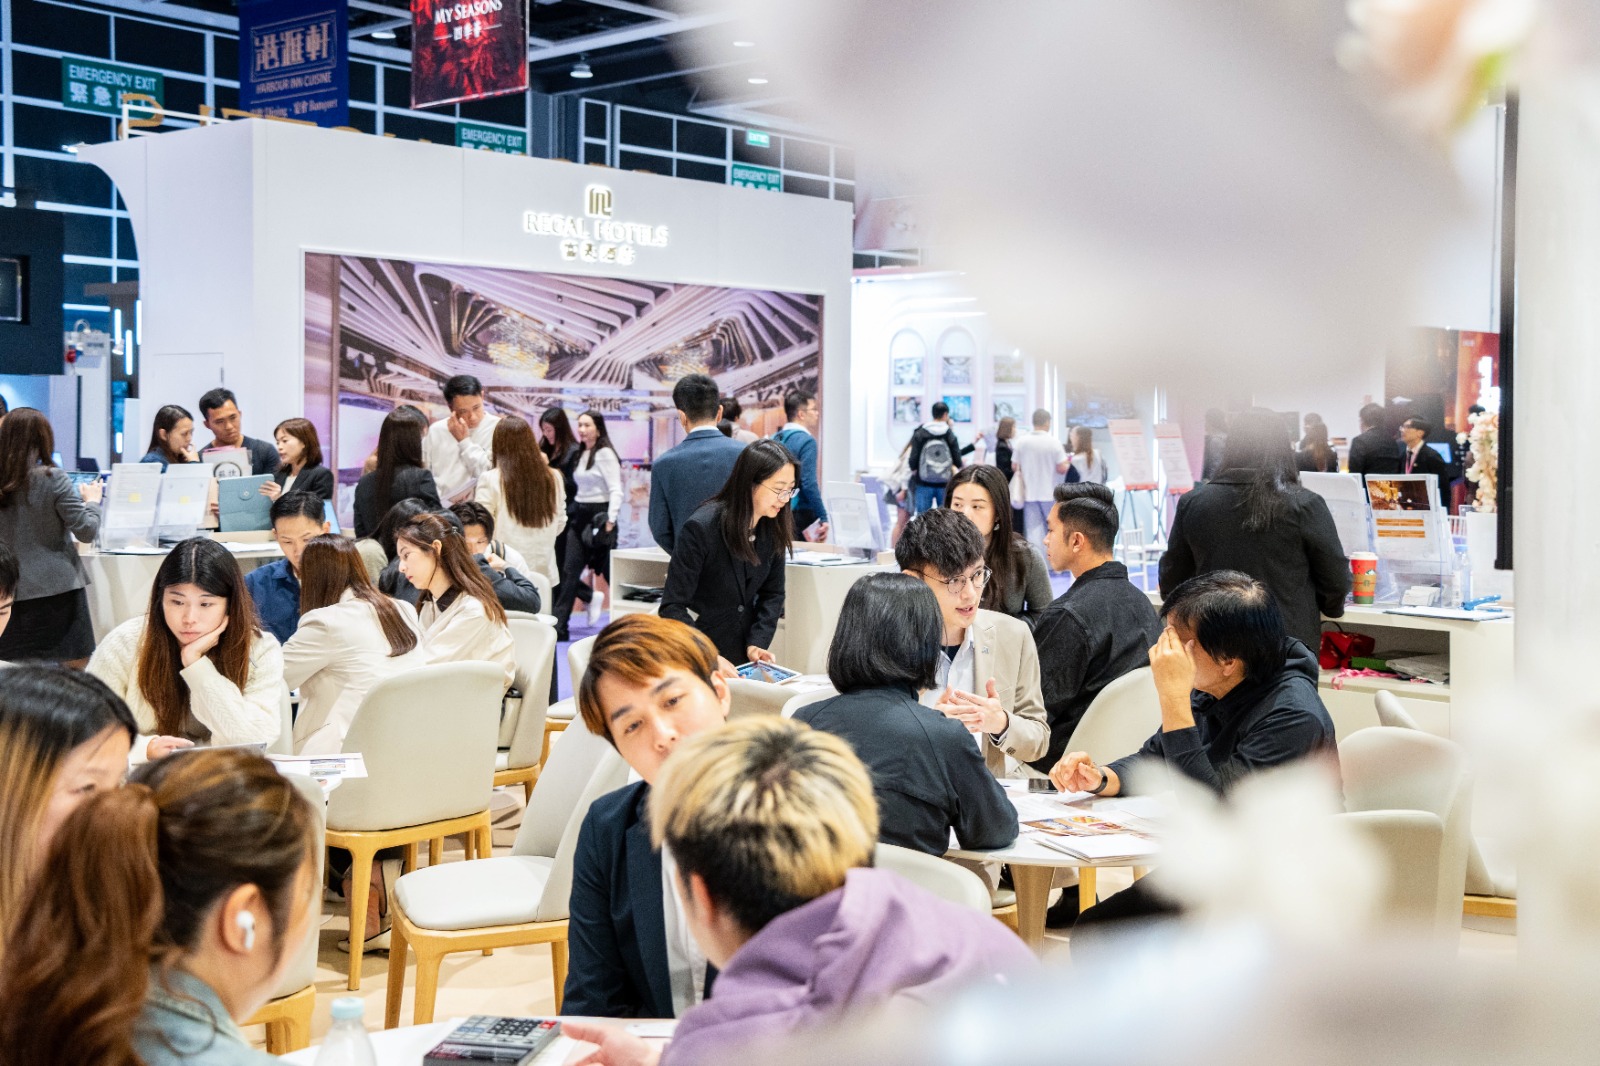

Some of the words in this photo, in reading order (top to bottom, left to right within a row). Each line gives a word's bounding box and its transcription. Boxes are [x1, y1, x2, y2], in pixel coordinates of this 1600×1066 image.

[434, 8, 454, 24] MY
[454, 0, 503, 21] SEASONS
[69, 65, 133, 88] EMERGENCY
[134, 75, 157, 91] EXIT
[256, 78, 289, 94] HARBOUR
[290, 76, 303, 89] INN
[303, 71, 332, 87] CUISINE
[461, 127, 507, 145] EMERGENCY
[507, 135, 523, 147] EXIT
[525, 211, 590, 239] REGAL
[595, 220, 669, 247] HOTELS
